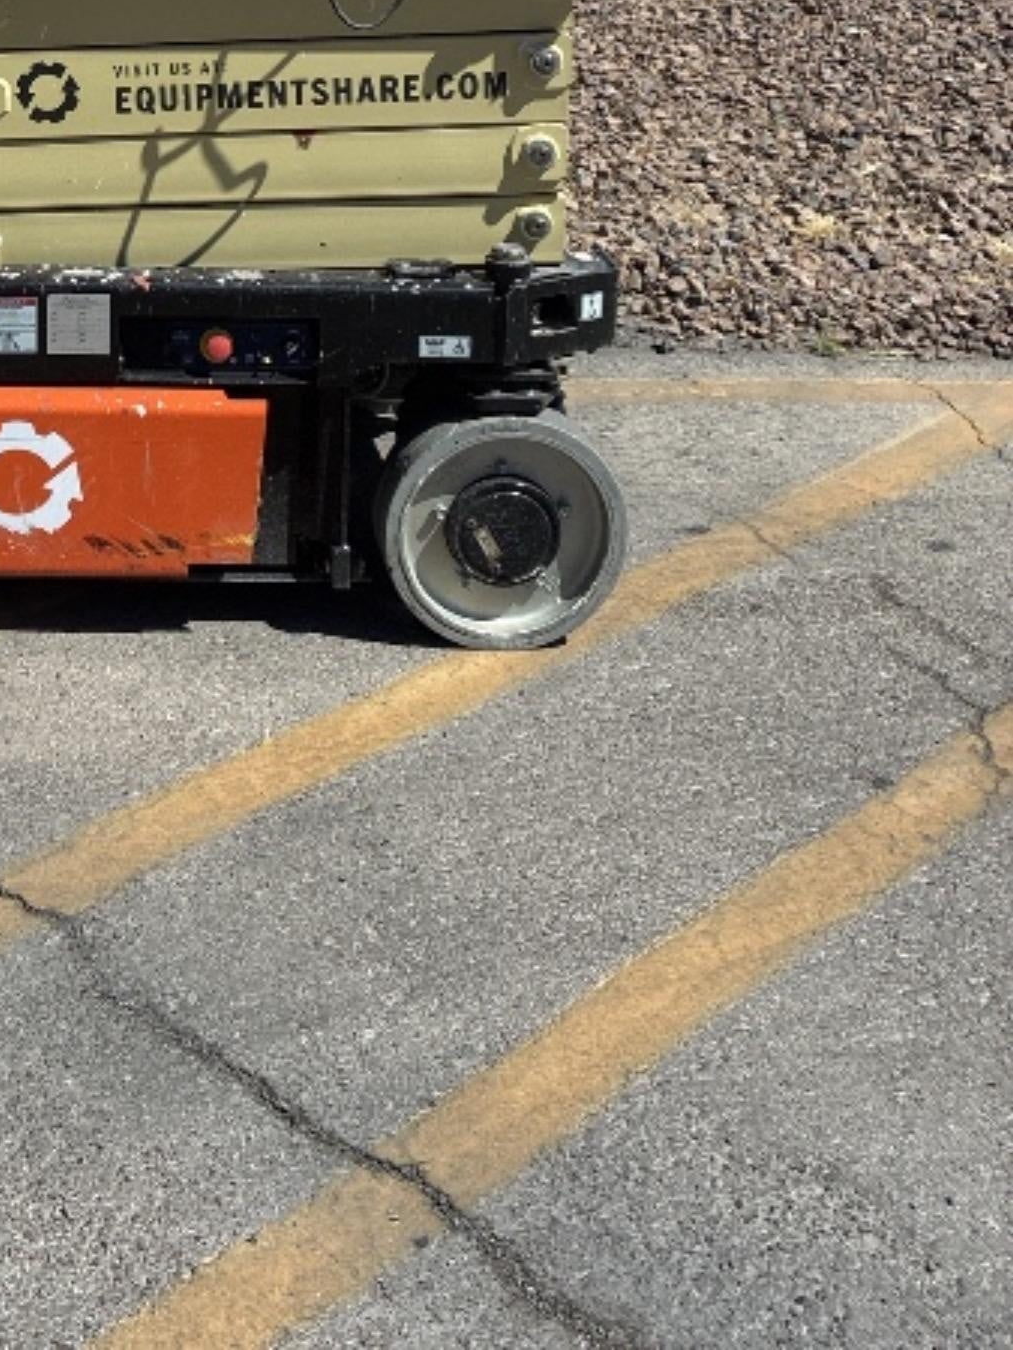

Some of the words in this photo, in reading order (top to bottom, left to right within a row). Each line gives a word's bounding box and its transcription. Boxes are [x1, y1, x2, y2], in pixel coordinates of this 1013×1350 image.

[112, 62, 161, 78] VISIT
[169, 61, 192, 76] US
[114, 71, 509, 115] EQUIPMENTSHARE.COM
